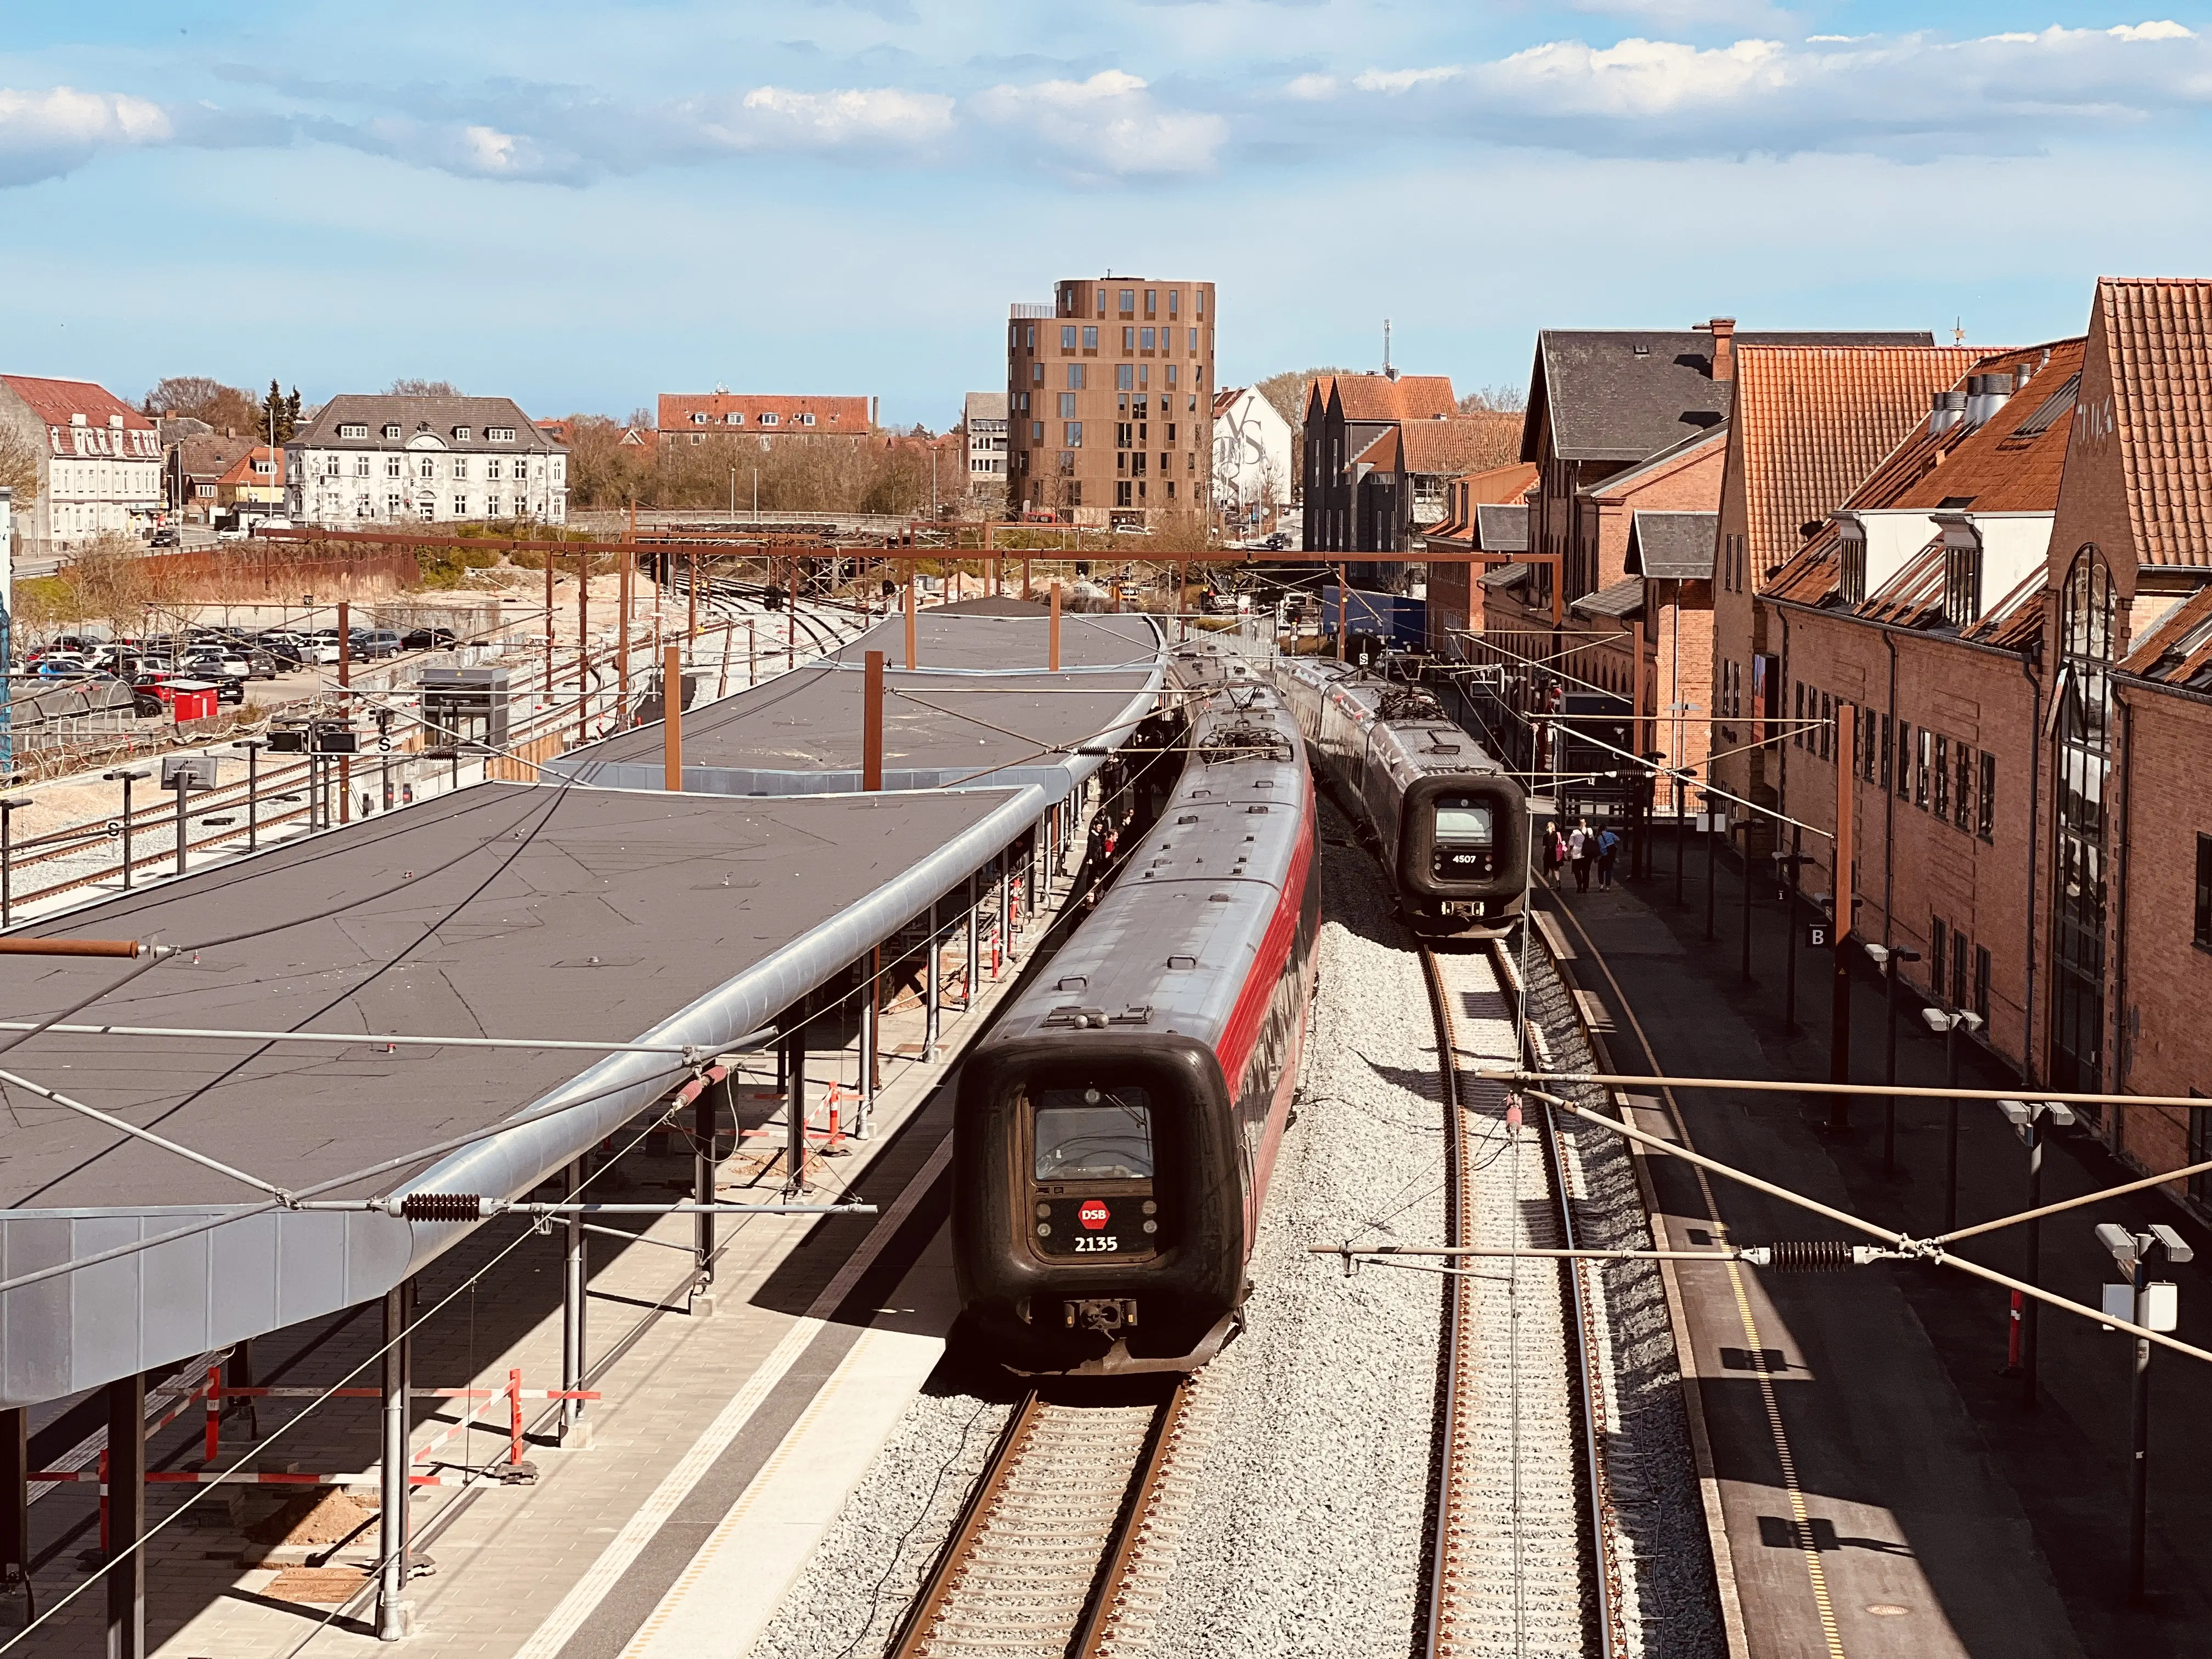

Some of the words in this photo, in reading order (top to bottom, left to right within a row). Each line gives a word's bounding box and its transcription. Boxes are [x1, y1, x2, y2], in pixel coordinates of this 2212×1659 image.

[1361, 654, 1368, 663] S
[379, 737, 391, 752] S
[108, 822, 120, 837] S
[1452, 855, 1476, 864] 4507
[1812, 929, 1824, 945] B
[1081, 1210, 1107, 1220] DSB
[1075, 1236, 1118, 1252] 2135
